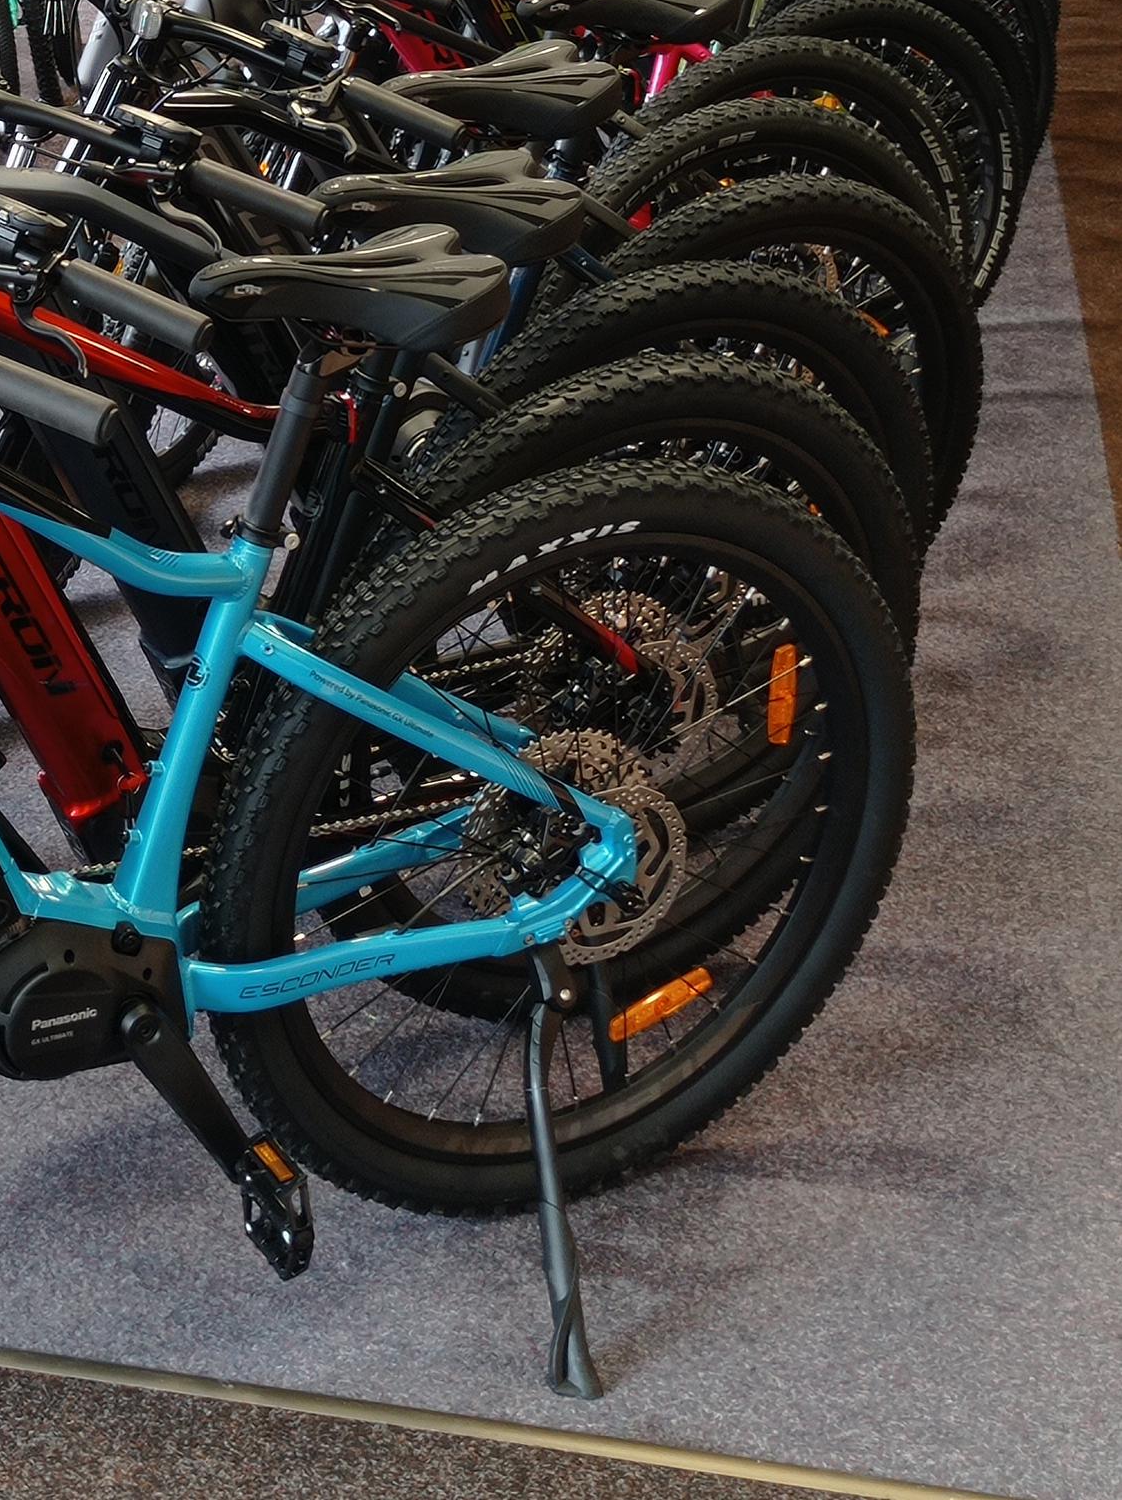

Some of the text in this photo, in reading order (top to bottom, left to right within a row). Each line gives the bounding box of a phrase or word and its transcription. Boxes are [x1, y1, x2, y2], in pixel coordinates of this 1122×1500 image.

[467, 520, 641, 596] MAXXIS
[309, 670, 345, 694] Powered
[344, 688, 356, 700] by
[356, 692, 392, 716] Panasonic
[392, 712, 403, 723] GX
[239, 953, 395, 999] ESCONDER
[31, 1006, 98, 1032] Panasonic
